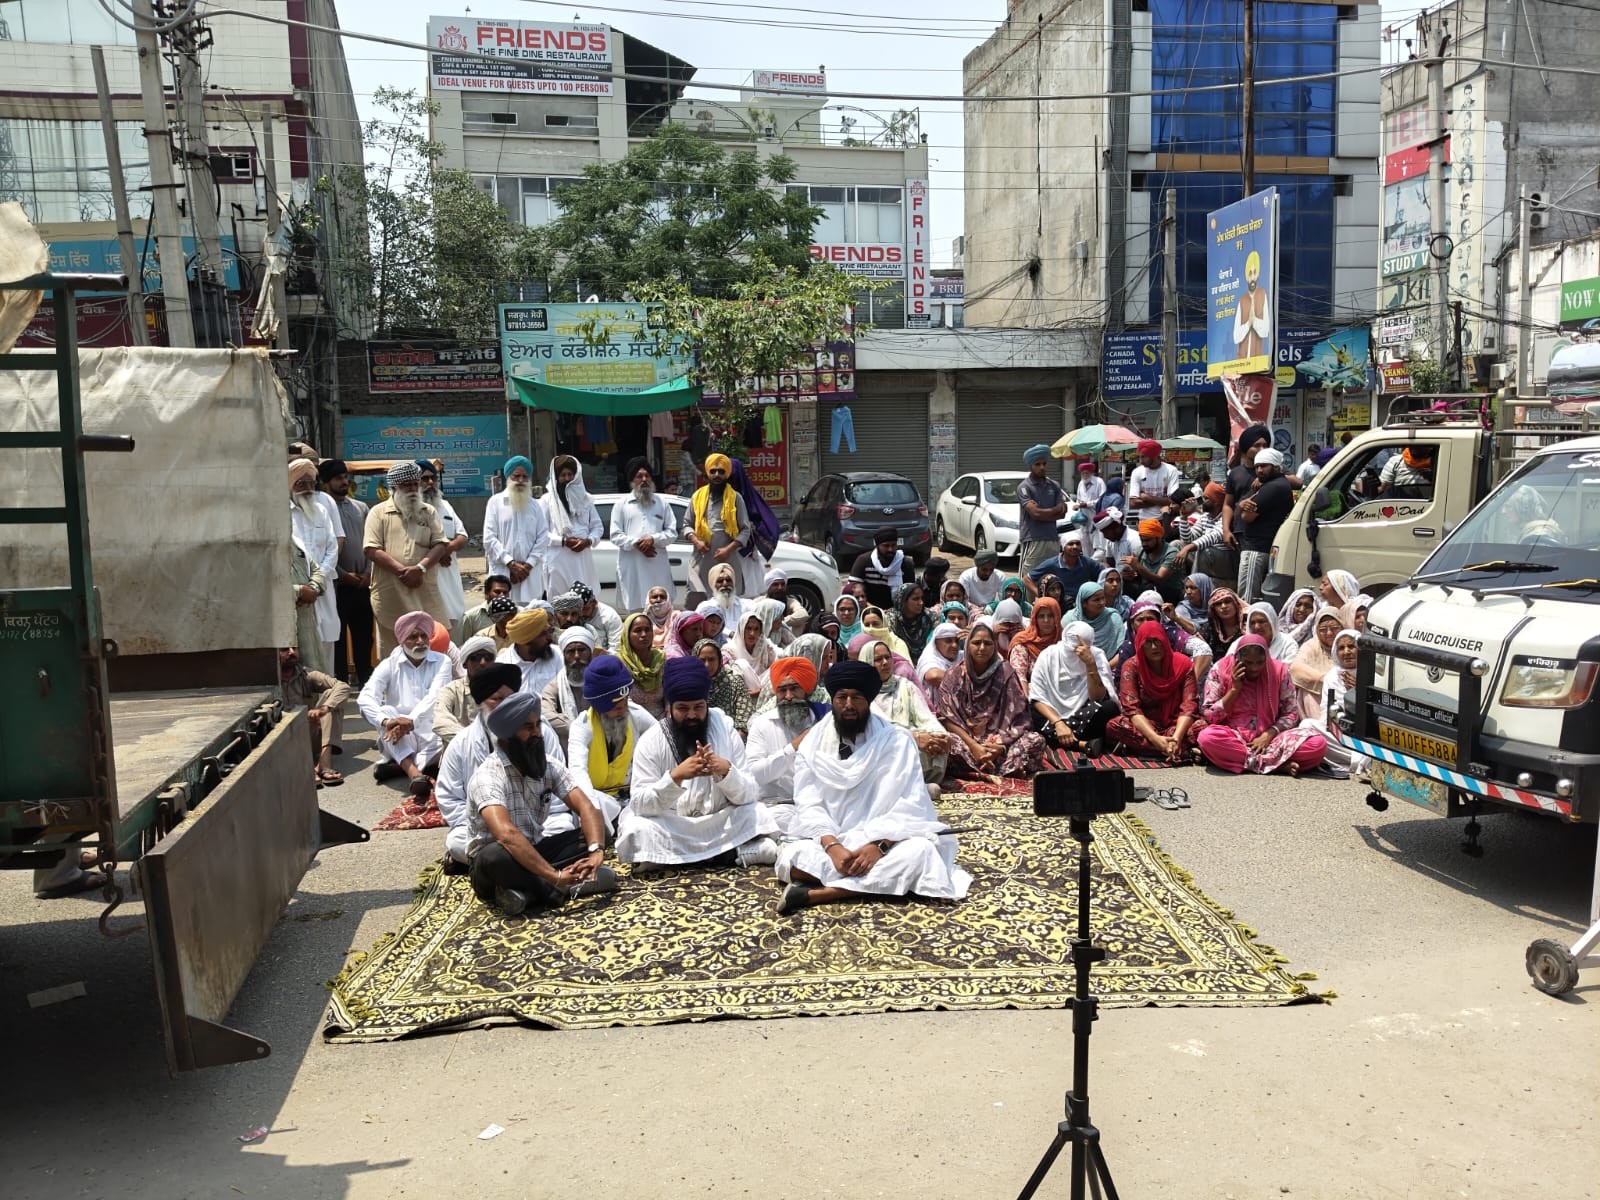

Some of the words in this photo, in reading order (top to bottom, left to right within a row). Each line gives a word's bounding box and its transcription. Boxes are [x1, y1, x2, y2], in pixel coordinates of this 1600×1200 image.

[477, 27, 606, 52] FRIENDS
[477, 47, 496, 56] THE
[499, 49, 519, 57] FINE
[522, 50, 543, 58] DINE
[546, 51, 607, 60] RESTAURANT
[438, 77, 460, 87] IDEAL
[462, 78, 487, 88] VENUE
[489, 79, 504, 89] FOR
[506, 81, 535, 90] GUESTS
[537, 81, 556, 91] UPTO
[560, 82, 573, 92] 100
[575, 83, 609, 93] PERSONS
[772, 73, 824, 85] FRIENDS
[808, 245, 902, 262] RIENDS
[913, 197, 924, 314] FRIENDS
[1384, 254, 1417, 274] STUDY
[939, 284, 964, 294] BRIT
[1563, 288, 1595, 311] NOW
[507, 338, 554, 360] ਏਅਰ
[1109, 350, 1135, 358] CANADA
[1108, 358, 1137, 366] AMERICA
[1108, 375, 1142, 383] AUSTRALIA
[1108, 383, 1123, 391] NEW
[1123, 382, 1152, 390] ZEALAND
[1353, 510, 1376, 520] Mom
[1399, 506, 1425, 516] Dad
[1408, 628, 1434, 643] LAND
[1434, 633, 1484, 652] CRUISER
